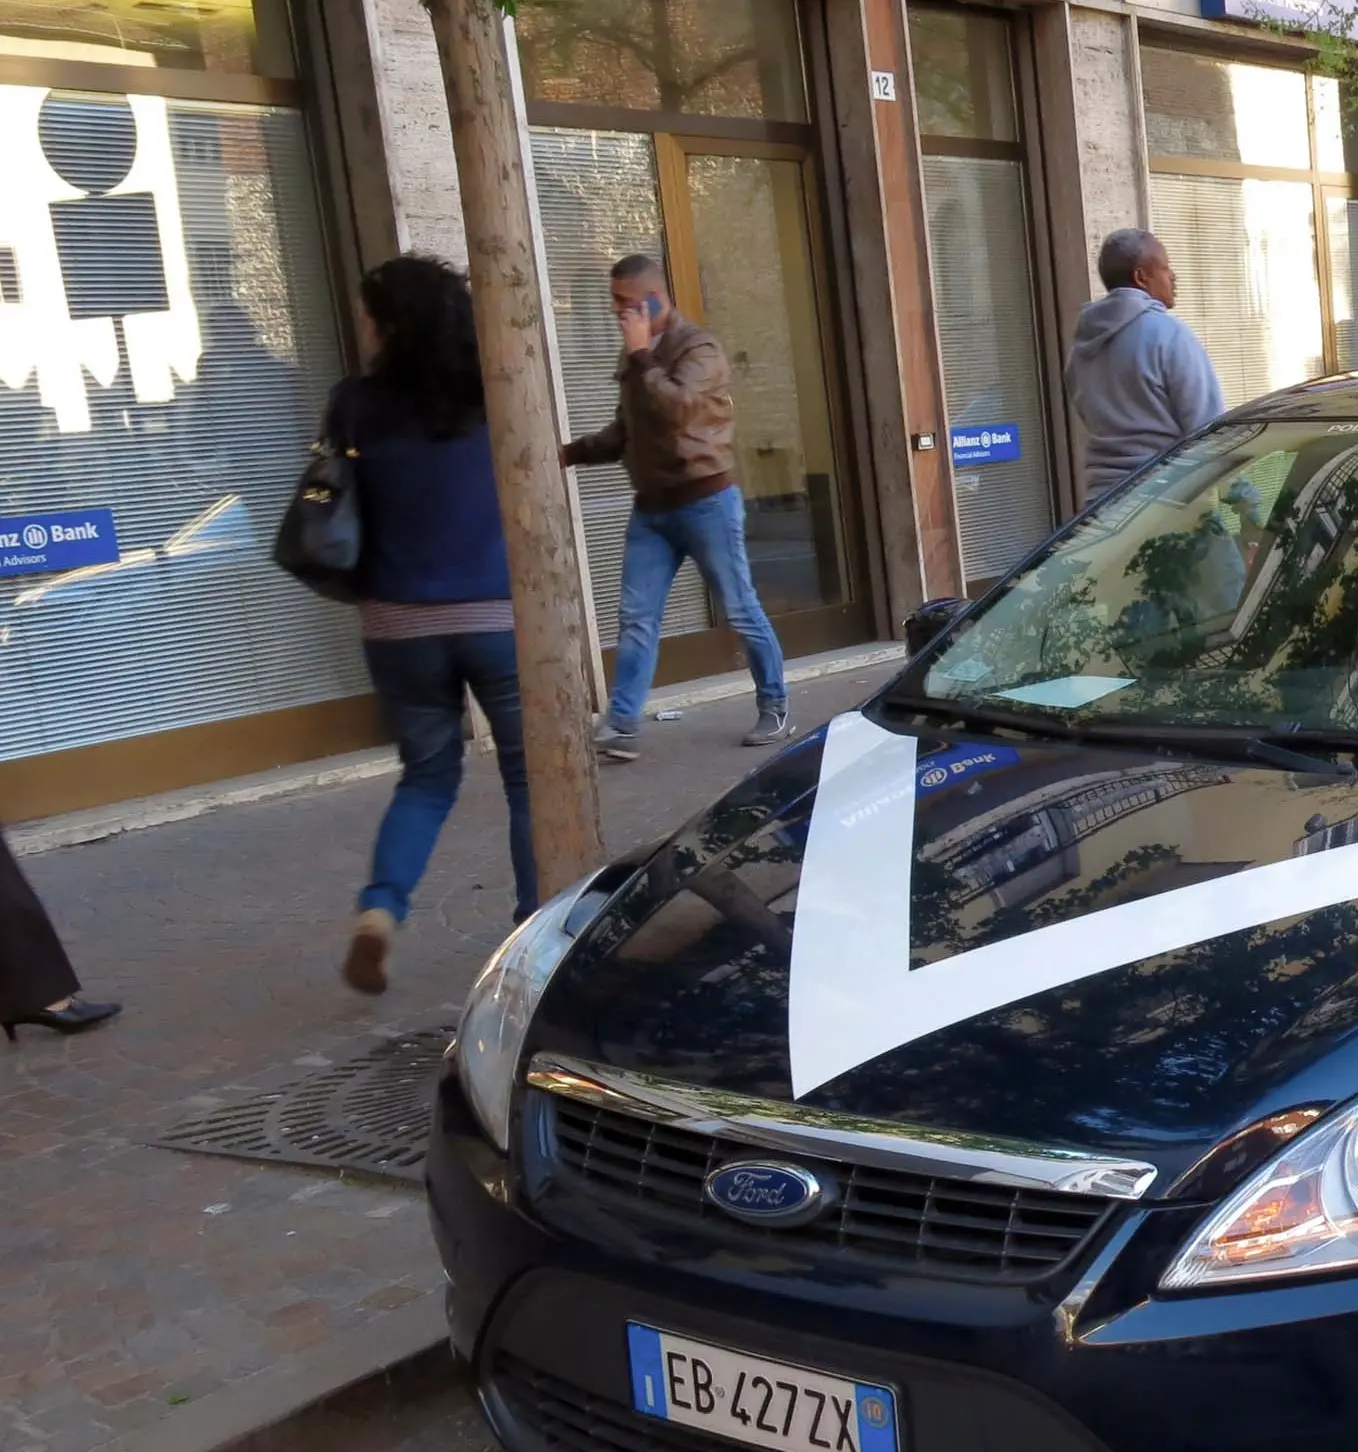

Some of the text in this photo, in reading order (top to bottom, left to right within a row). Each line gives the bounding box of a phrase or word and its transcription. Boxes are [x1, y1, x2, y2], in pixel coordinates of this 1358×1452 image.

[876, 76, 890, 96] 12
[953, 432, 1012, 448] Allianz Bank
[51, 522, 99, 542] Bank
[3, 553, 47, 567] Advisors
[727, 1171, 787, 1205] Ford
[667, 1351, 716, 1415] EB
[730, 1371, 857, 1452] 427ZX
